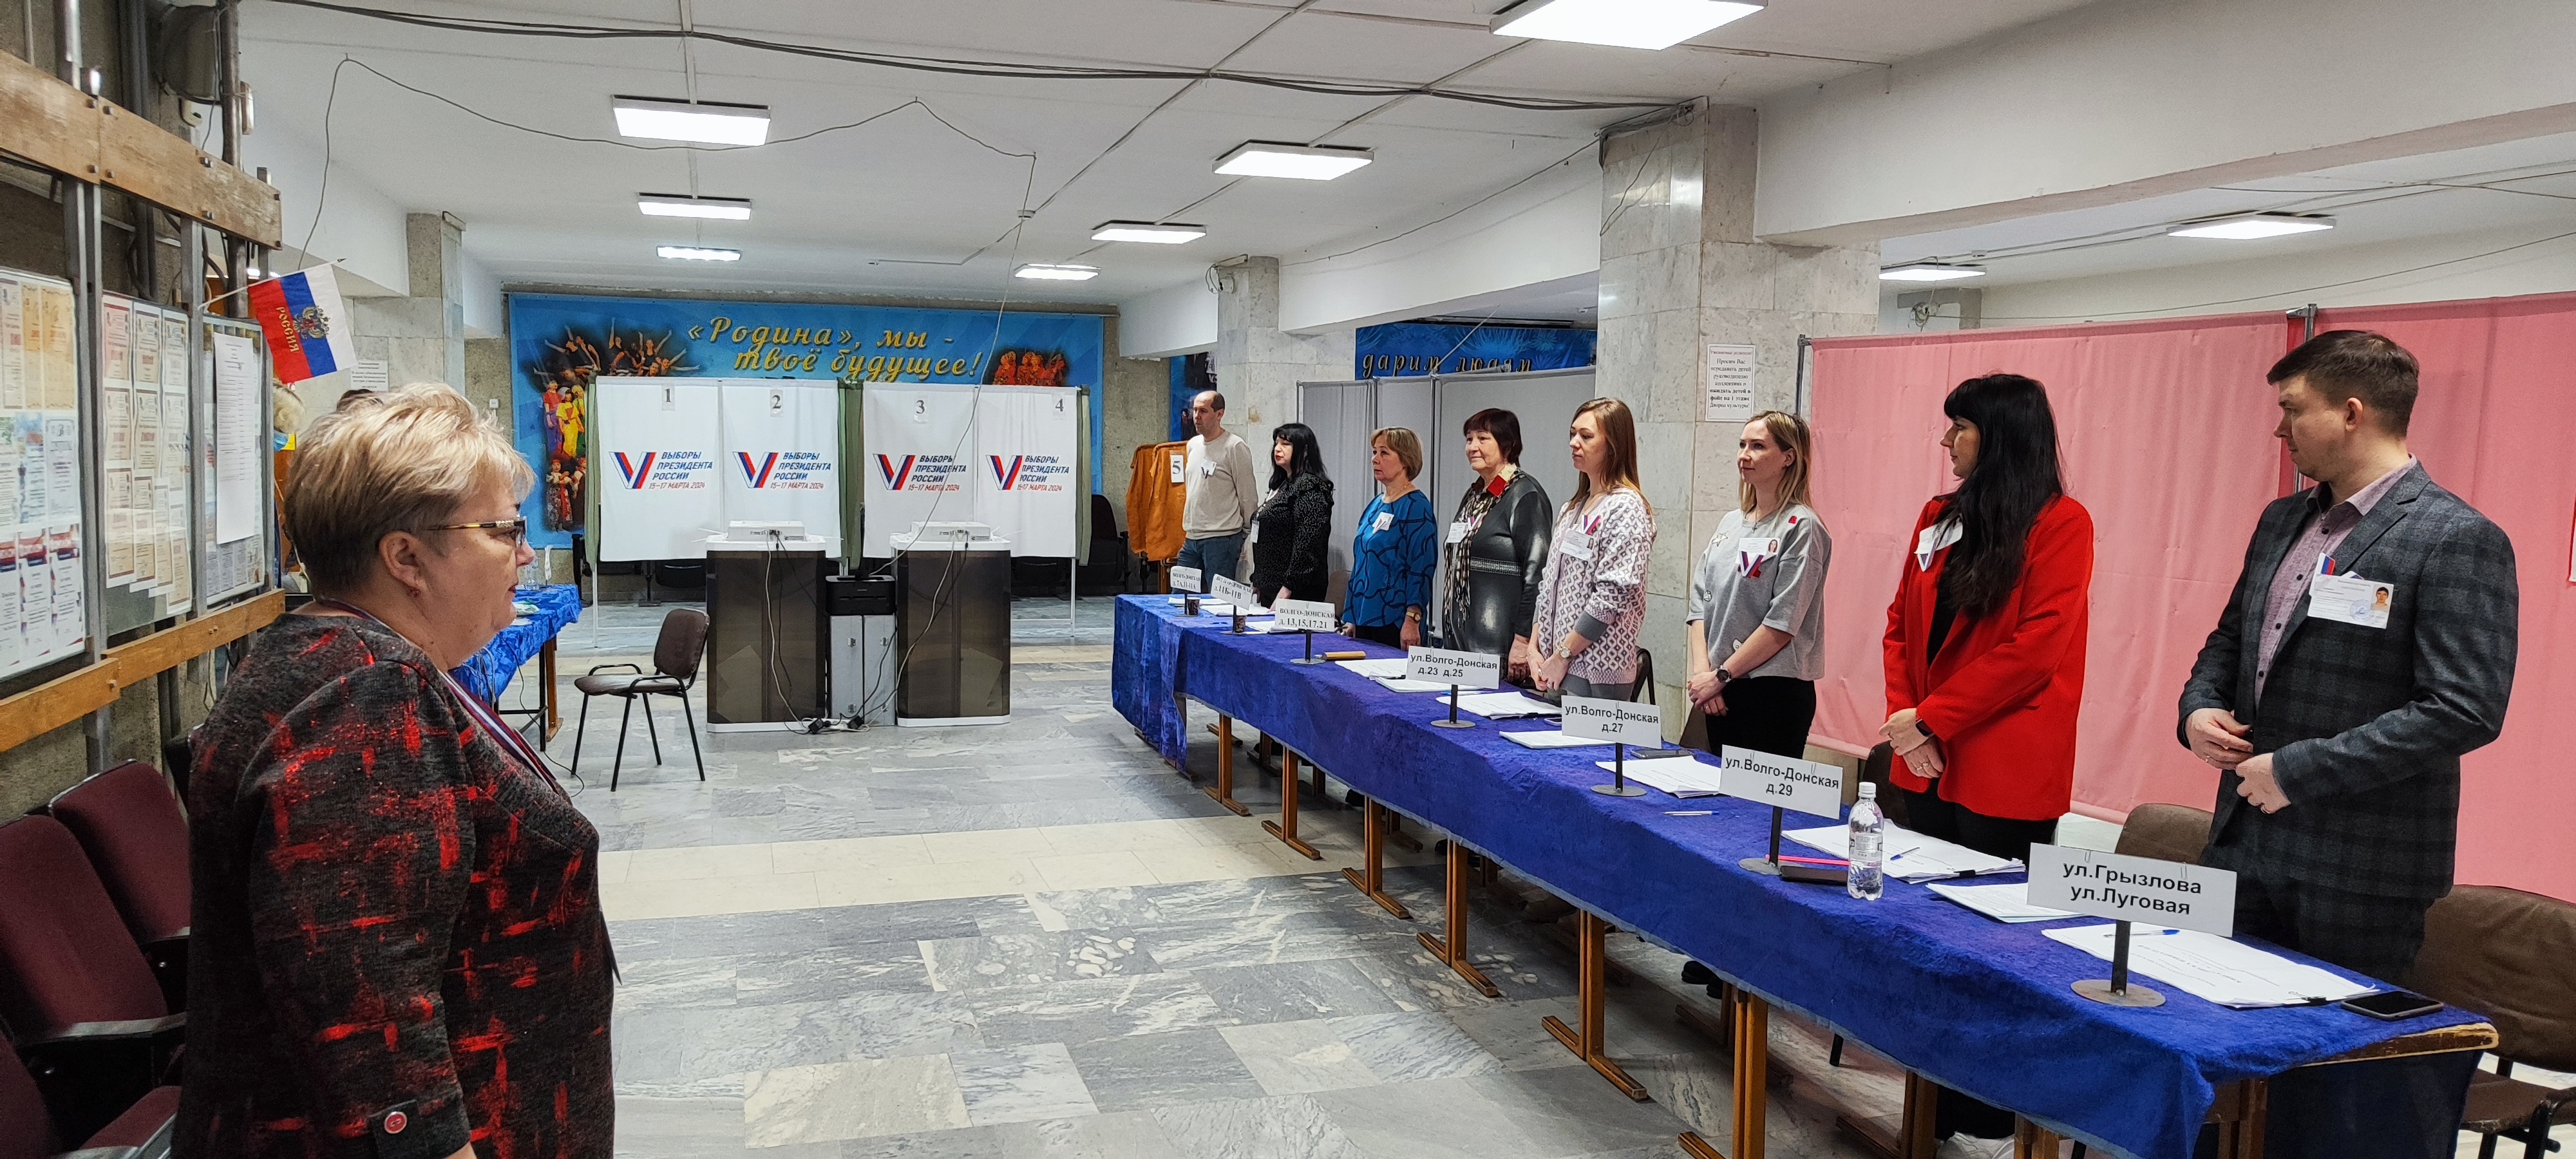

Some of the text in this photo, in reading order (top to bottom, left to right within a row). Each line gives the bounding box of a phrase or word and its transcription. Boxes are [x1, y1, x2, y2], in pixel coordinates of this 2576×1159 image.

[276, 306, 300, 352] РОССИЯ
[876, 328, 928, 349] мы
[734, 347, 983, 383] твоё будущее!
[1362, 353, 1441, 378] дарим
[665, 388, 672, 402] 1
[772, 394, 782, 409] 2
[916, 399, 925, 414] 3
[1055, 398, 1064, 412] 4
[657, 462, 713, 470] ПРЕЗИДЕНТА
[778, 462, 831, 471] ПРЕЗИДЕНТА
[1025, 455, 1059, 464] ВЫБОРЫ
[1022, 465, 1070, 474] ПРЕЗИДЕНТА
[1173, 461, 1180, 475] 5
[652, 472, 690, 480] РОССИИ
[1280, 608, 1334, 618] ВОЛГО-ДОНСКАЯ
[1410, 654, 1498, 670] ул.Волго-Донская
[1417, 667, 1464, 678] д.23 д.25
[1565, 704, 1660, 724] ул.Волго-Донская
[1601, 722, 1624, 734] д.27
[1725, 757, 1839, 789] ул.Волго-Донская
[1765, 783, 1793, 796] д.29
[2062, 862, 2202, 894] ул.Грызлова
[2070, 886, 2191, 915] ул.Луговая
